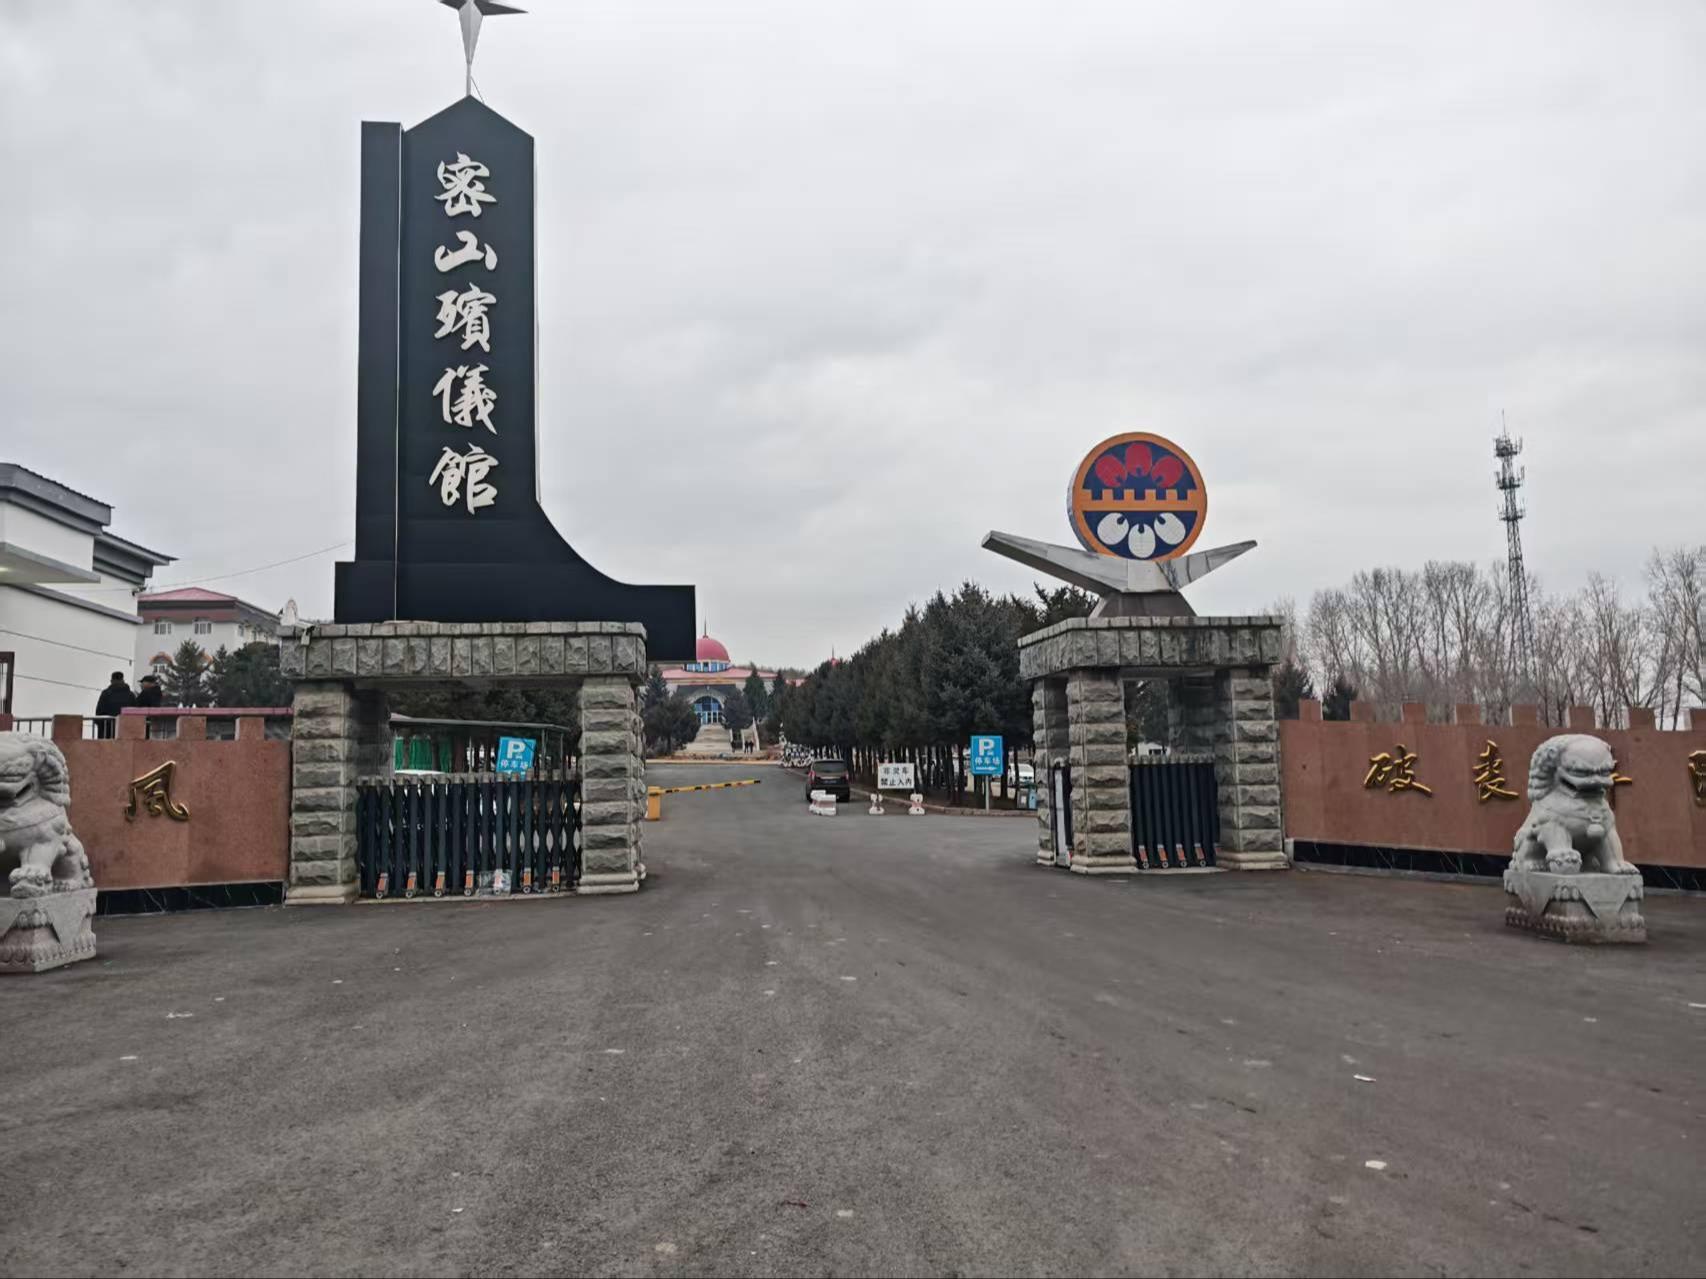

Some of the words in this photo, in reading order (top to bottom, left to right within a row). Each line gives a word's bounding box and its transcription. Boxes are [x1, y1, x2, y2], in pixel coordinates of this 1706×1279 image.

[429, 151, 500, 515] 密山殯儀館
[507, 741, 526, 758] P
[979, 738, 995, 756] P
[975, 756, 1001, 766] 停车场
[880, 777, 912, 787] 禁止入内
